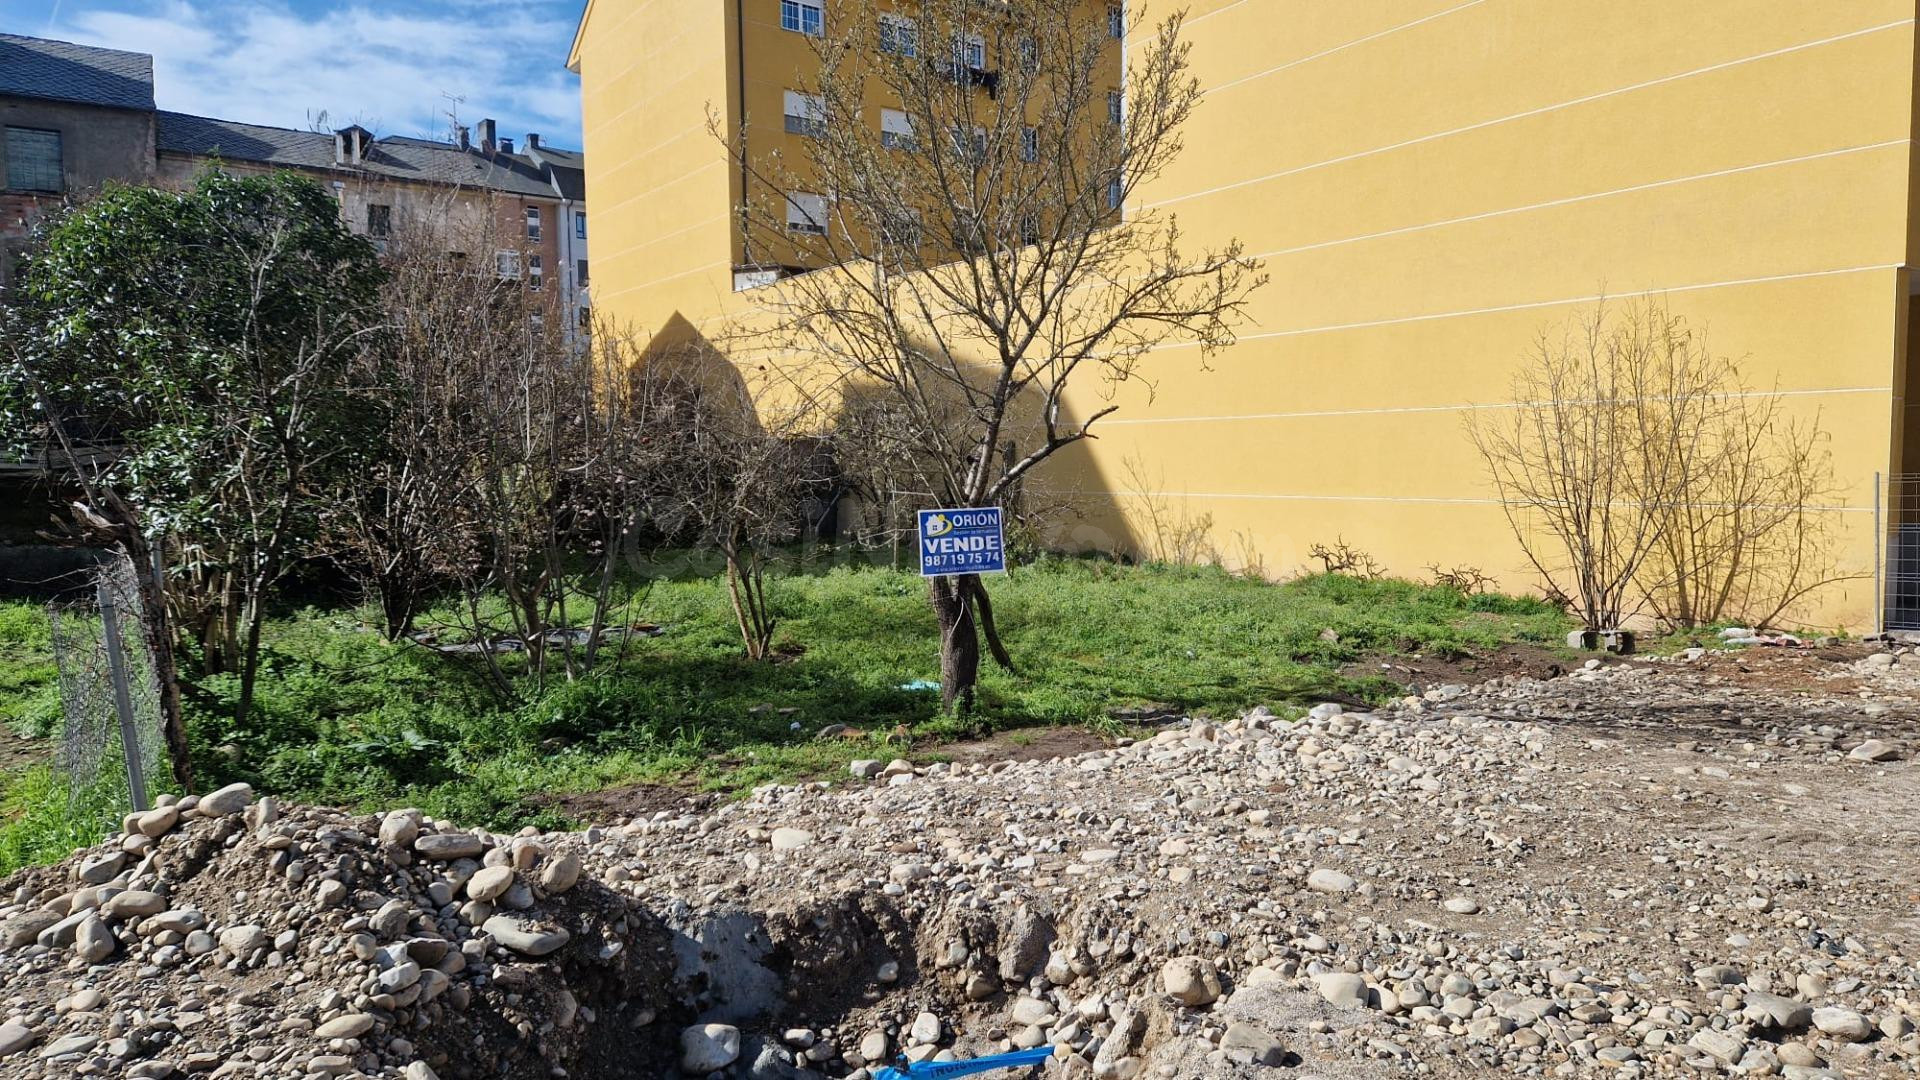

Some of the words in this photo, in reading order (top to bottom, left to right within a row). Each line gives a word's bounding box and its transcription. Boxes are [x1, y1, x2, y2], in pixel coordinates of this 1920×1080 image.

[952, 512, 998, 527] ORIÓN
[924, 535, 1000, 554] VENDE
[925, 555, 948, 566] 987
[951, 553, 965, 565] 19
[967, 552, 983, 564] 75
[985, 551, 1000, 563] 74
